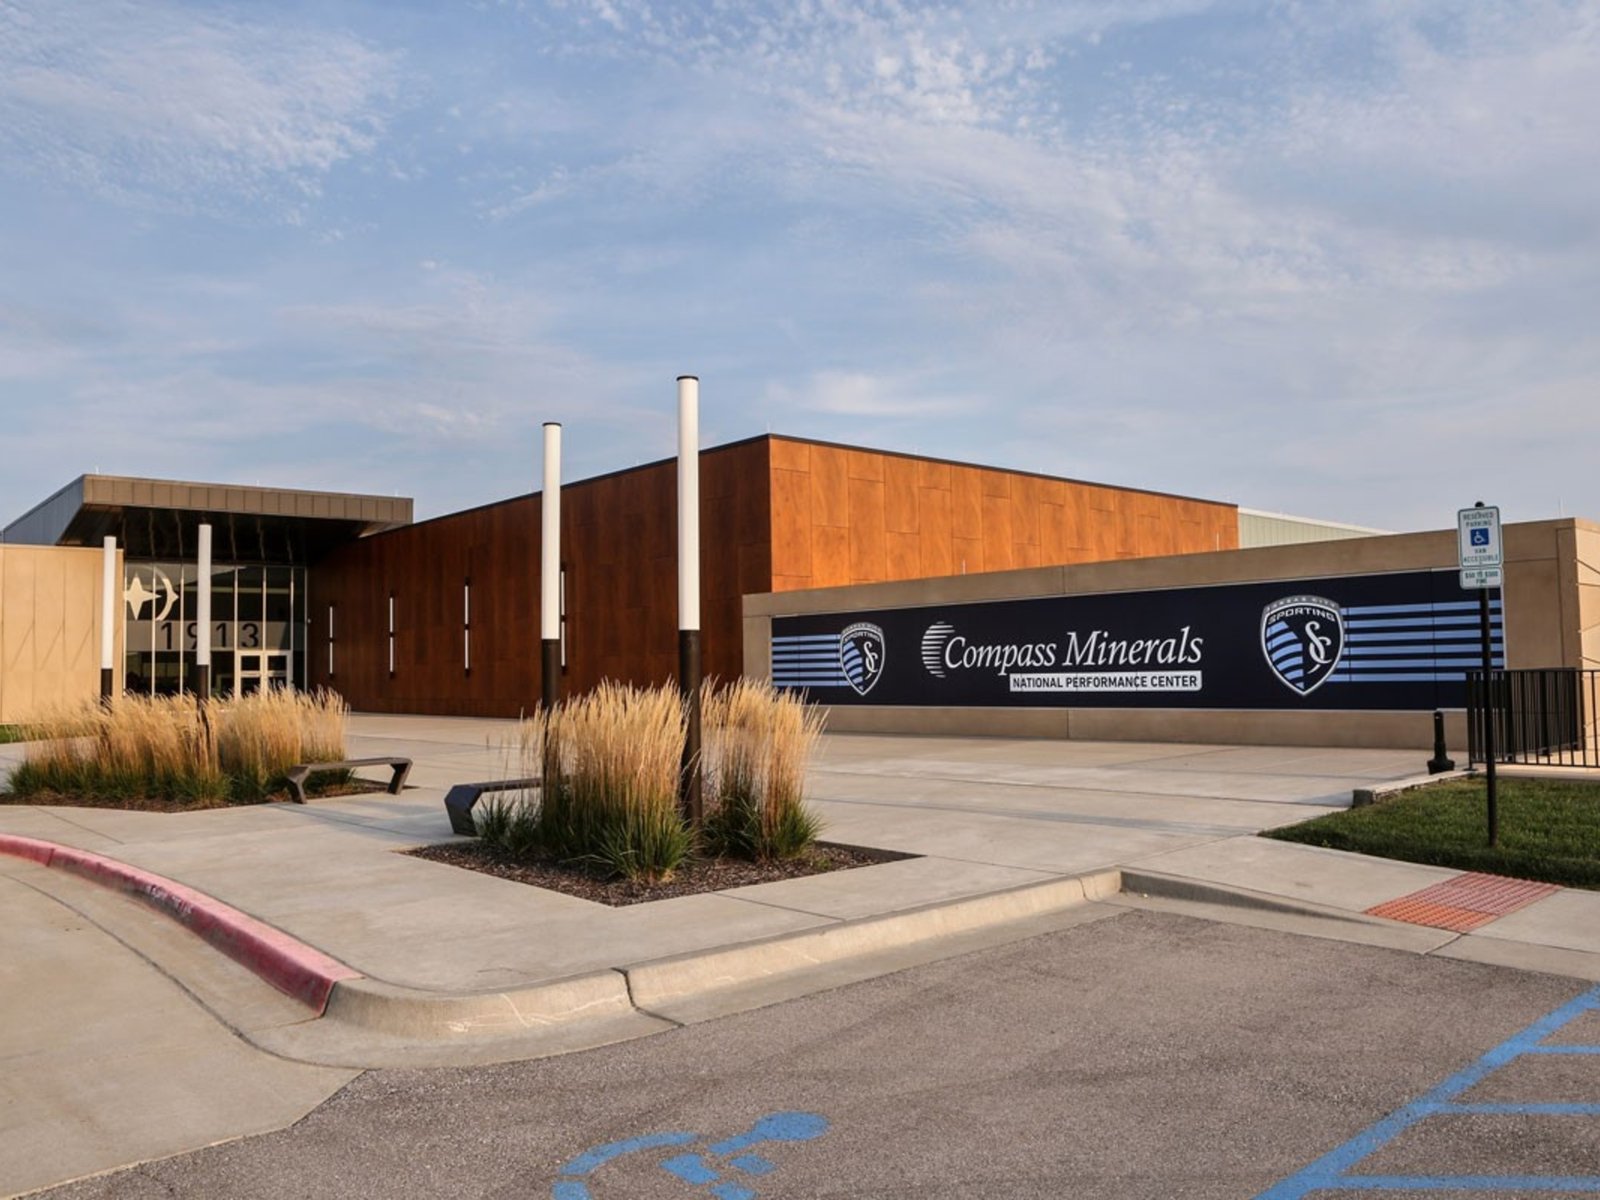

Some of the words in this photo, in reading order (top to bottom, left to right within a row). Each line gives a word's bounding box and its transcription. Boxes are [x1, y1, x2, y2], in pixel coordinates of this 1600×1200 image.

[1268, 607, 1336, 624] SPORTING
[944, 636, 1057, 676] Compass
[1061, 625, 1204, 666] Minerals
[1012, 677, 1063, 688] NATIONAL
[1066, 676, 1148, 688] PERFORMANCE
[1150, 675, 1197, 687] CENTER
